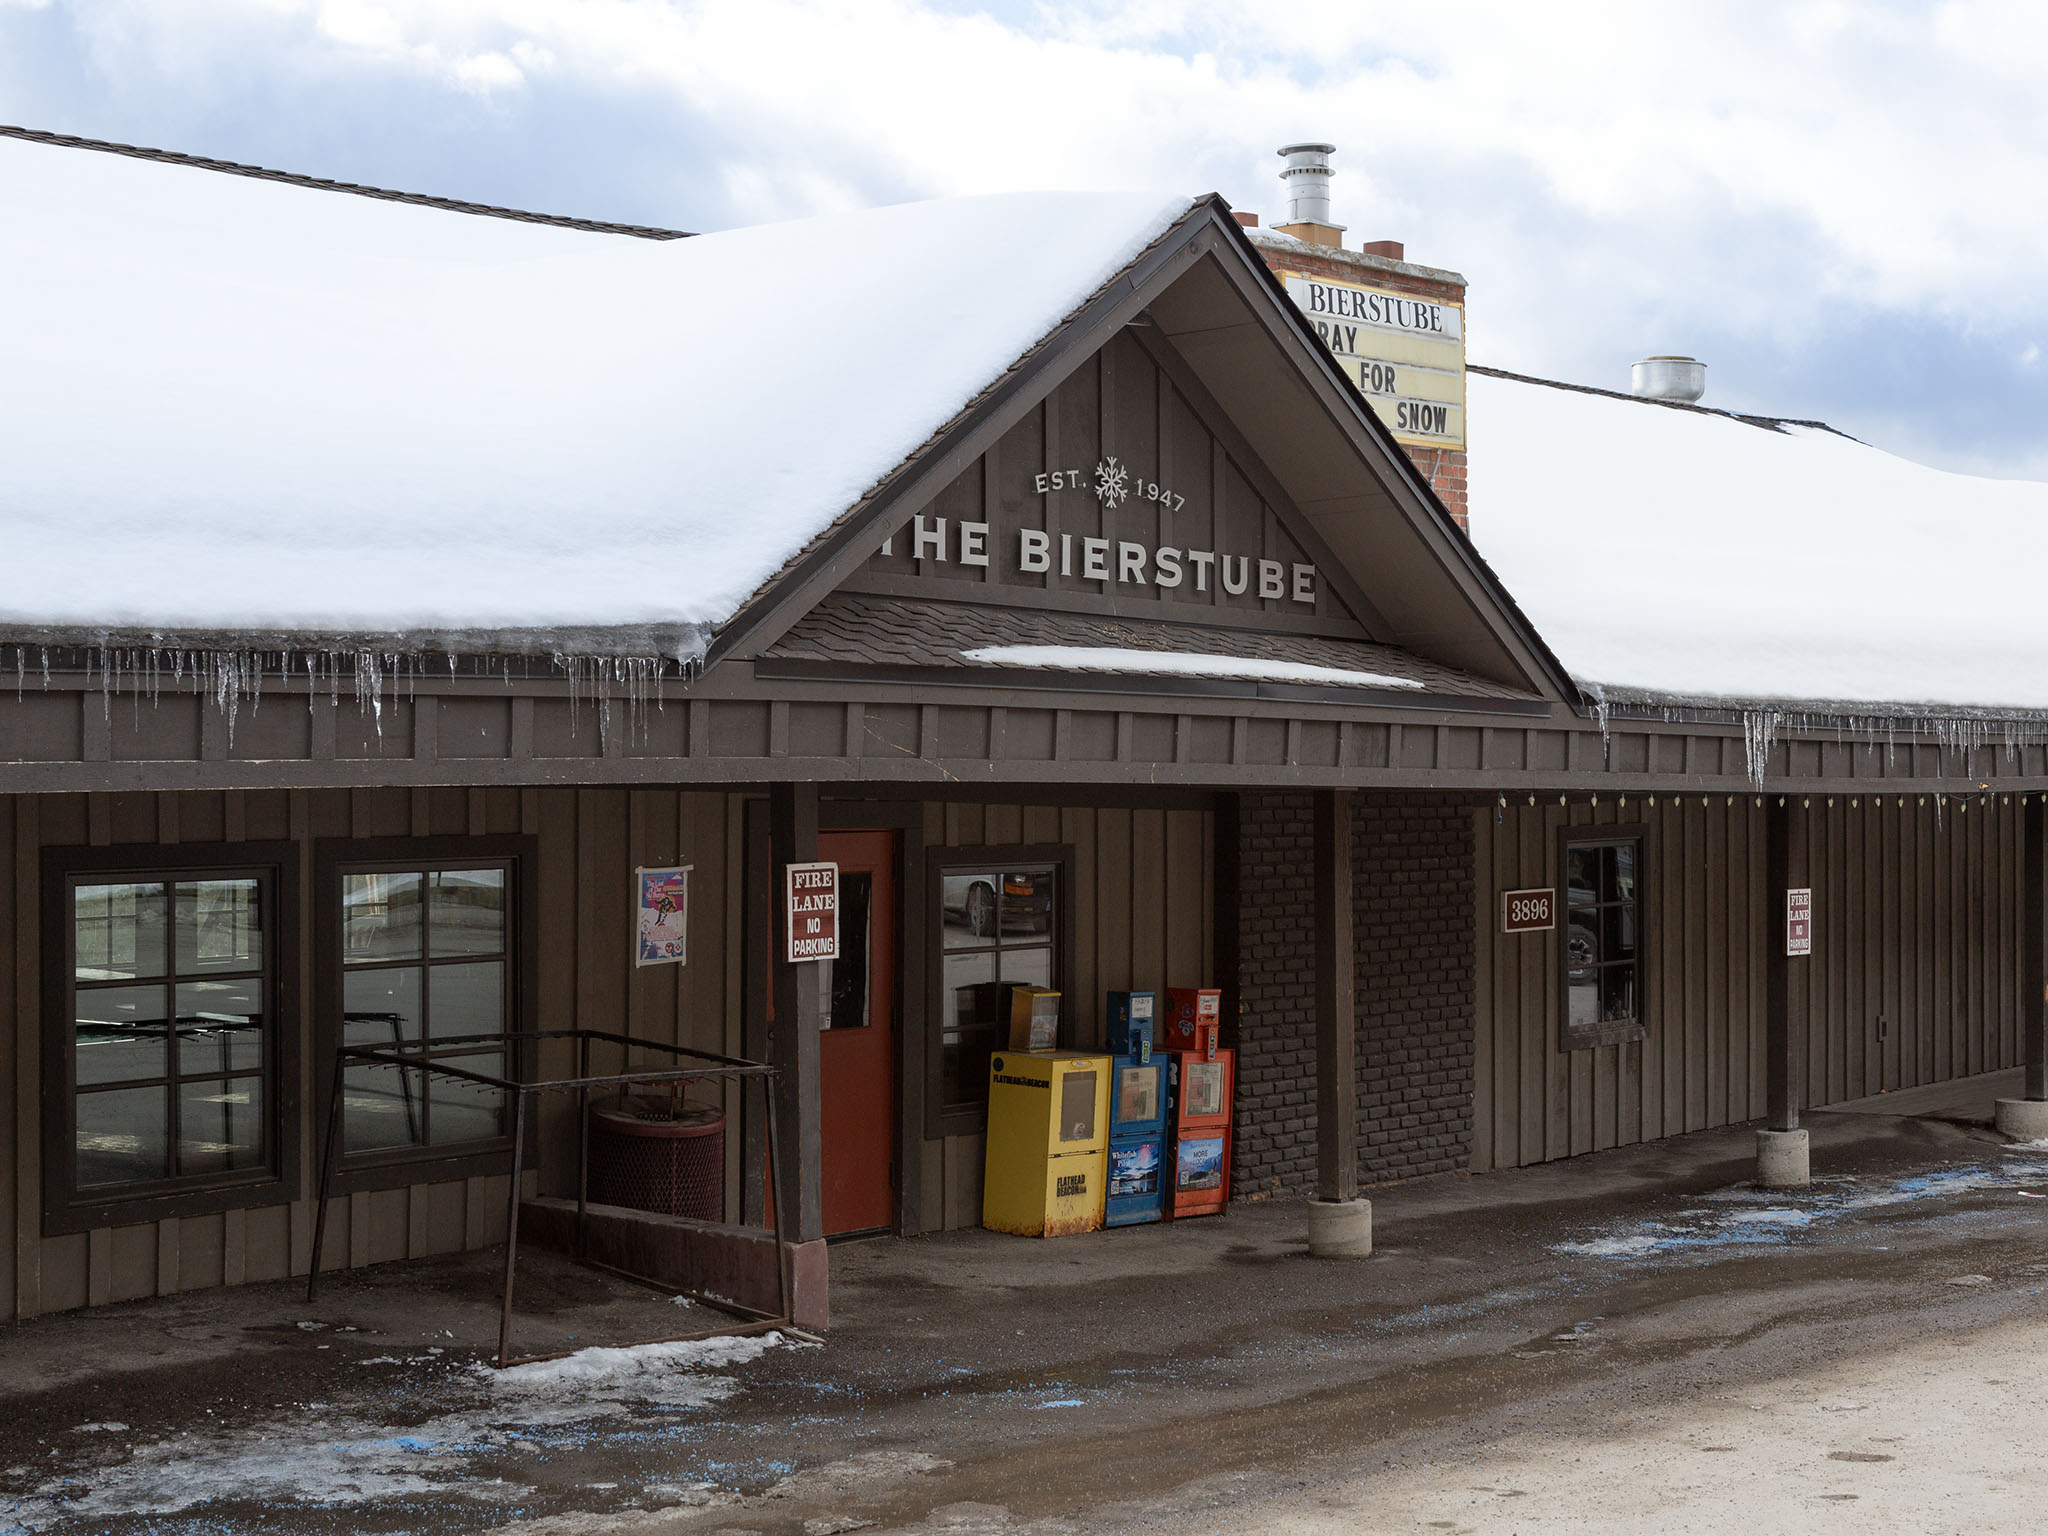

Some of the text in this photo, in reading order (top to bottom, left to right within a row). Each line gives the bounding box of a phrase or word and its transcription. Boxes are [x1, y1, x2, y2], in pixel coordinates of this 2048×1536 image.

[1309, 284, 1443, 332] BIERSTUBE
[1311, 321, 1357, 353] RAY
[1360, 362, 1396, 393] FOR
[1397, 402, 1447, 433] SNOW
[1035, 469, 1186, 512] EST. 1947
[1019, 528, 1316, 603] BIERSTUBE
[794, 871, 832, 889] FIRE
[792, 894, 834, 912] LANE
[1791, 895, 1808, 906] FIRE
[1511, 898, 1548, 922] 3896
[1790, 910, 1809, 921] LANE
[807, 917, 821, 934] NO
[1795, 925, 1803, 936] NO
[794, 937, 833, 956] PARKING
[1790, 938, 1809, 950] PARKING
[993, 1074, 1050, 1088] FLATHEAD BEACON
[1193, 1149, 1209, 1158] MORE
[1056, 1173, 1086, 1187] FLATHEAD
[1056, 1184, 1079, 1198] BEACON
